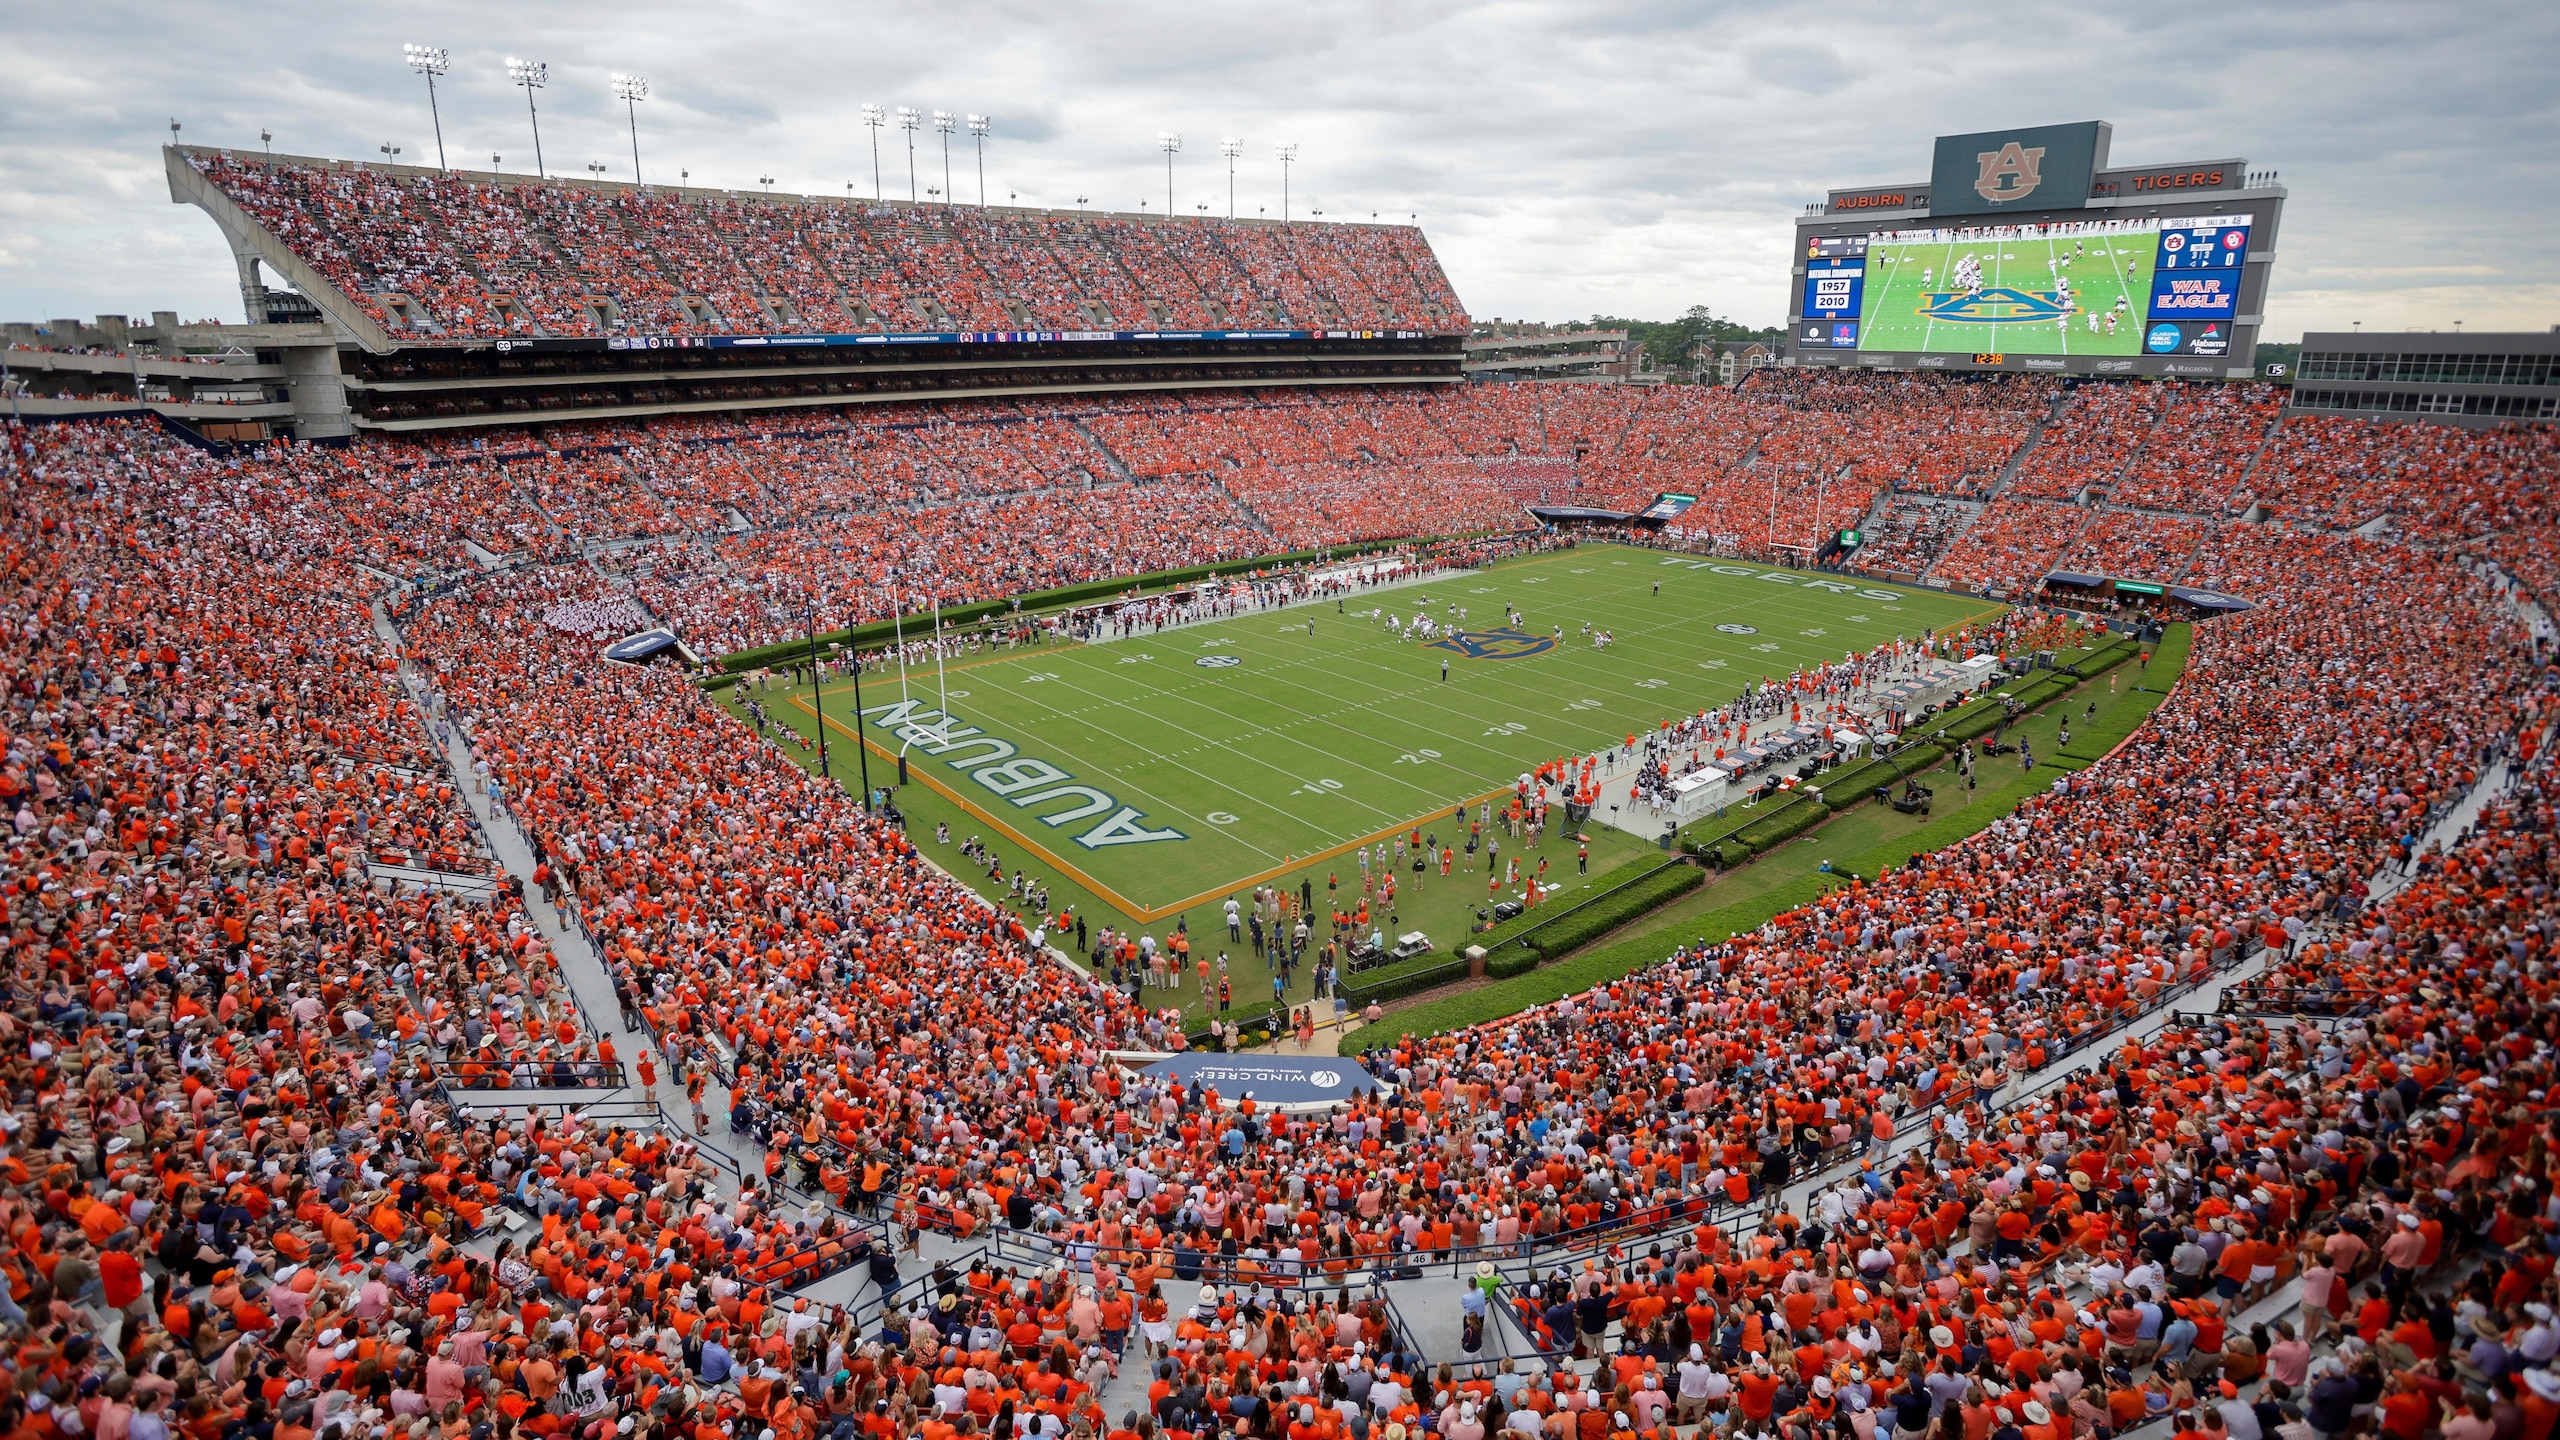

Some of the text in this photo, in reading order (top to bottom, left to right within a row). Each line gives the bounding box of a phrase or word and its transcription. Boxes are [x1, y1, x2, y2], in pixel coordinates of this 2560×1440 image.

[2134, 170, 2223, 191] TIGERS
[1835, 193, 1905, 210] AUBURN
[2169, 219, 2184, 229] 3RD
[2231, 216, 2242, 226] 48
[2167, 254, 2177, 268] 0
[2191, 251, 2198, 260] 3
[2204, 250, 2211, 259] 3
[2224, 252, 2235, 267] 0
[1821, 281, 1847, 291] 1957
[2171, 279, 2221, 294] WAR
[1819, 297, 1845, 307] 2010
[2157, 293, 2230, 308] EAGLE
[498, 342, 510, 350] CC
[2189, 339, 2227, 348] Alabama
[2194, 346, 2221, 355] Power
[1976, 353, 2003, 364] 12:38
[2272, 365, 2283, 375] 15
[1657, 556, 1906, 602] TIGERS
[1205, 637, 1236, 647] 30
[1122, 653, 1155, 663] 20
[1028, 672, 1061, 683] 10
[1634, 677, 1670, 690] 50
[947, 690, 971, 698] G
[1568, 698, 1603, 712] 40
[1490, 721, 1528, 737] 30
[1401, 748, 1442, 765] 20
[851, 698, 1192, 852] AUBURN
[1301, 778, 1345, 795] 10
[1206, 811, 1240, 825] G
[1195, 1070, 1307, 1083] WIND CREEK
[1608, 1077, 1618, 1087] 34
[1603, 1200, 1616, 1213] 23
[1413, 1254, 1426, 1264] 46
